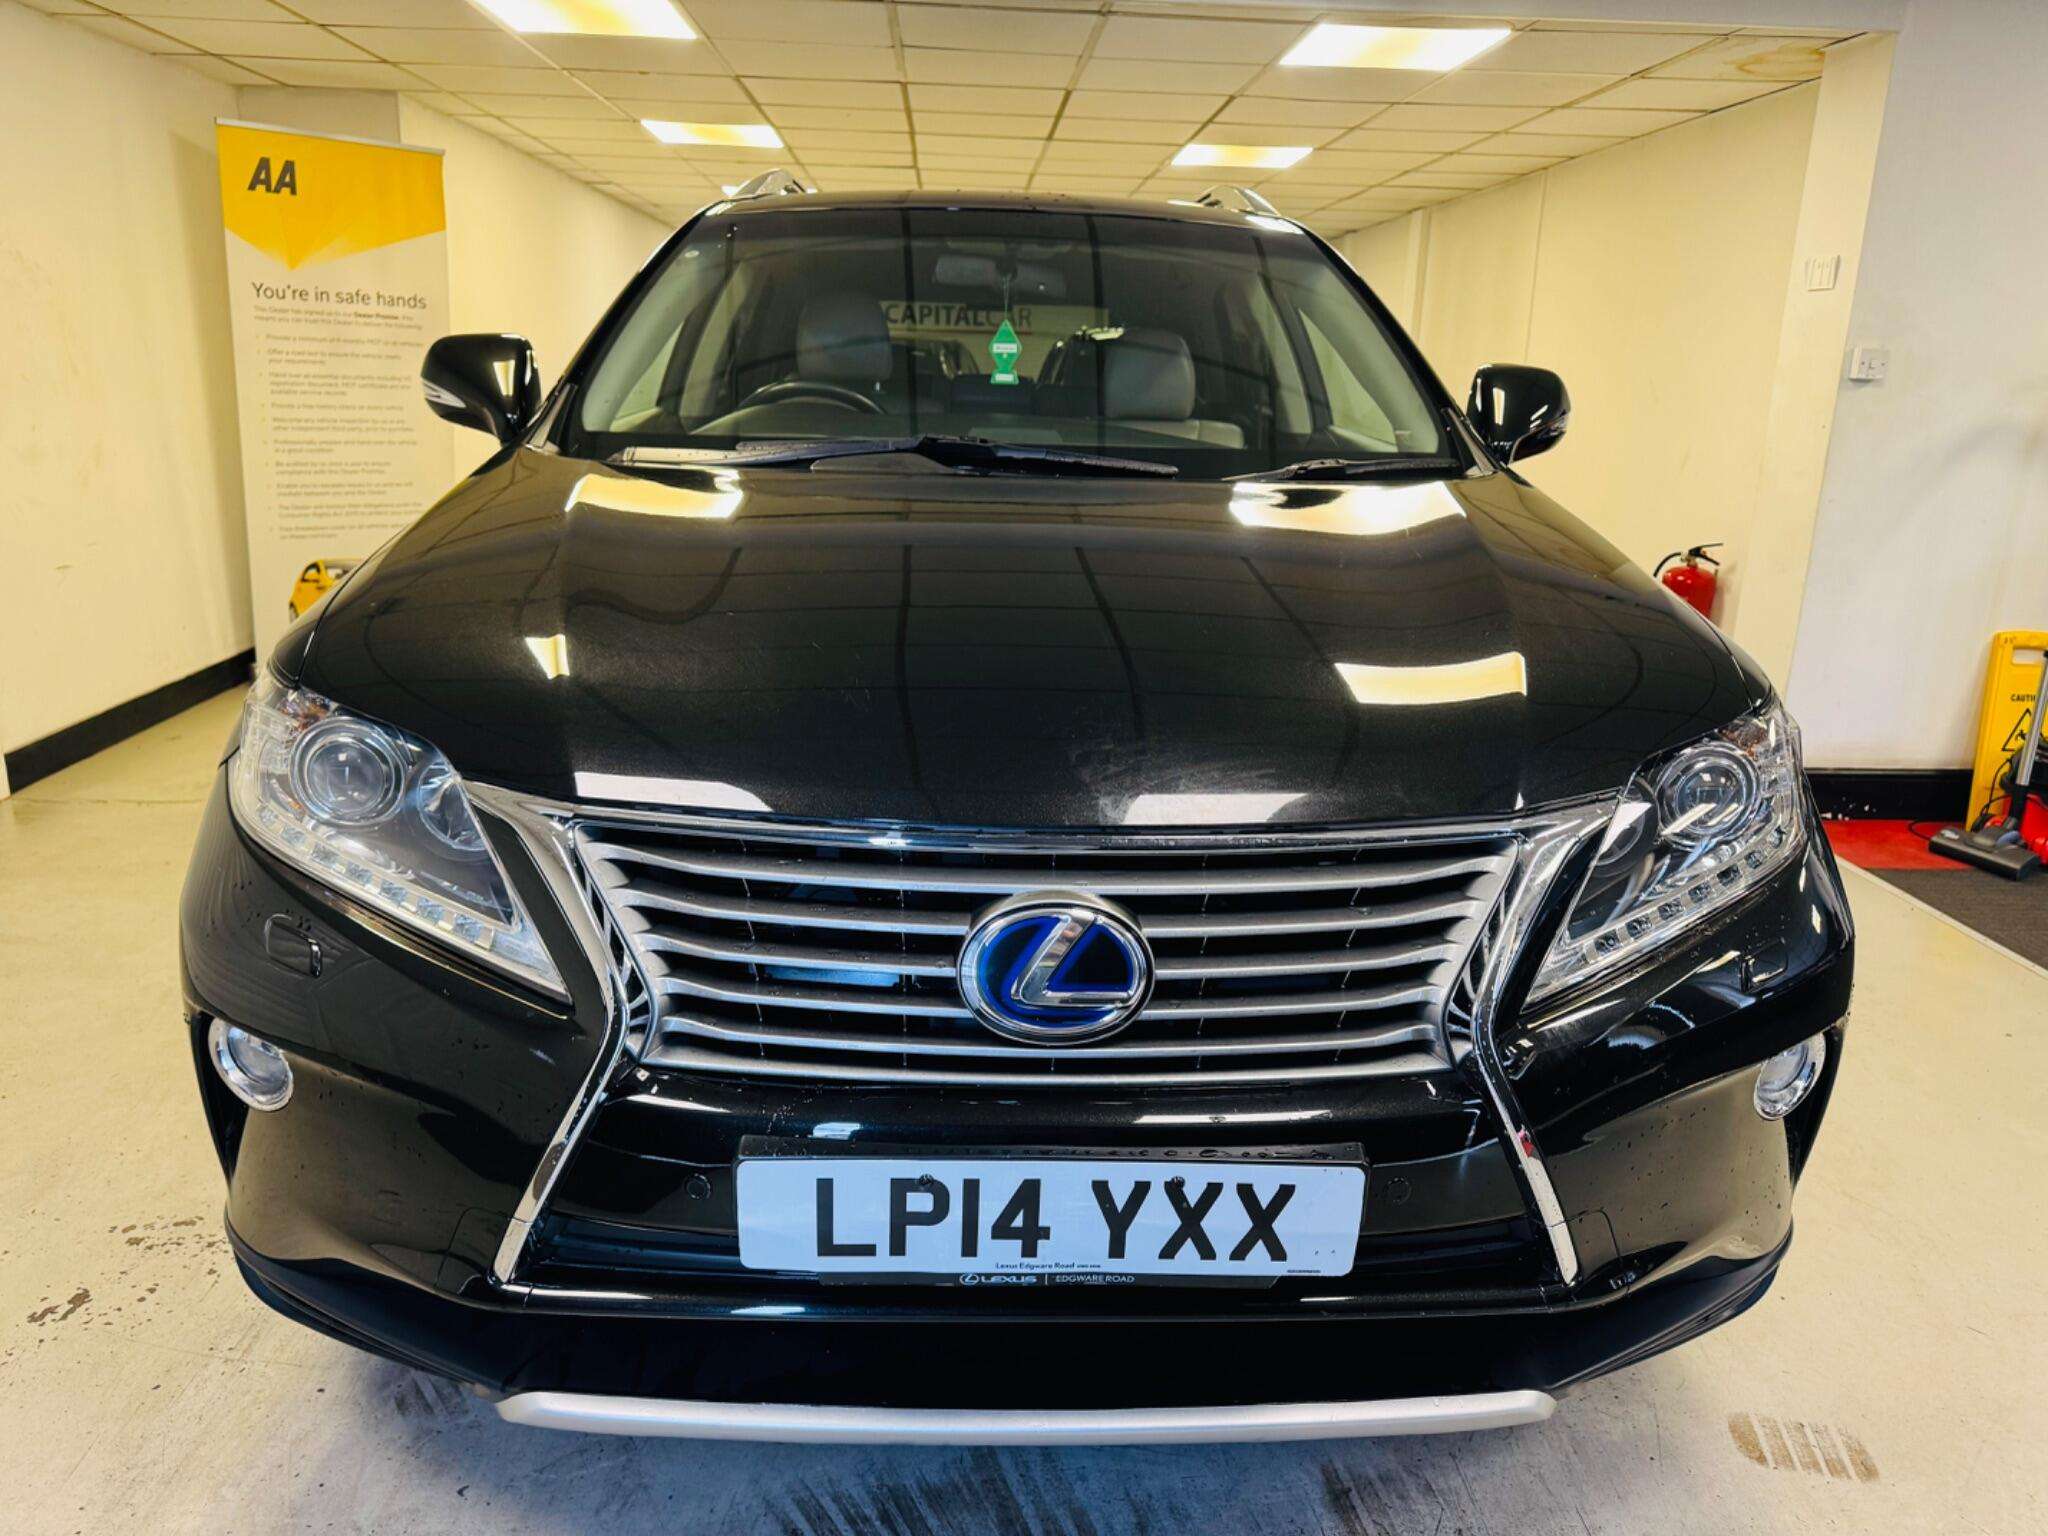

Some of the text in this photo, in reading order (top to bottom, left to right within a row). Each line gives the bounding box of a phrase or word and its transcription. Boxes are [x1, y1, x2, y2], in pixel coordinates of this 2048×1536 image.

[247, 156, 297, 195] AA
[252, 281, 428, 310] You're in safe hands
[816, 1177, 1296, 1263] LP14 YXX
[981, 1274, 1135, 1284] LEXUS EDGWARE ROAD
[1019, 1262, 1052, 1270] Edgware
